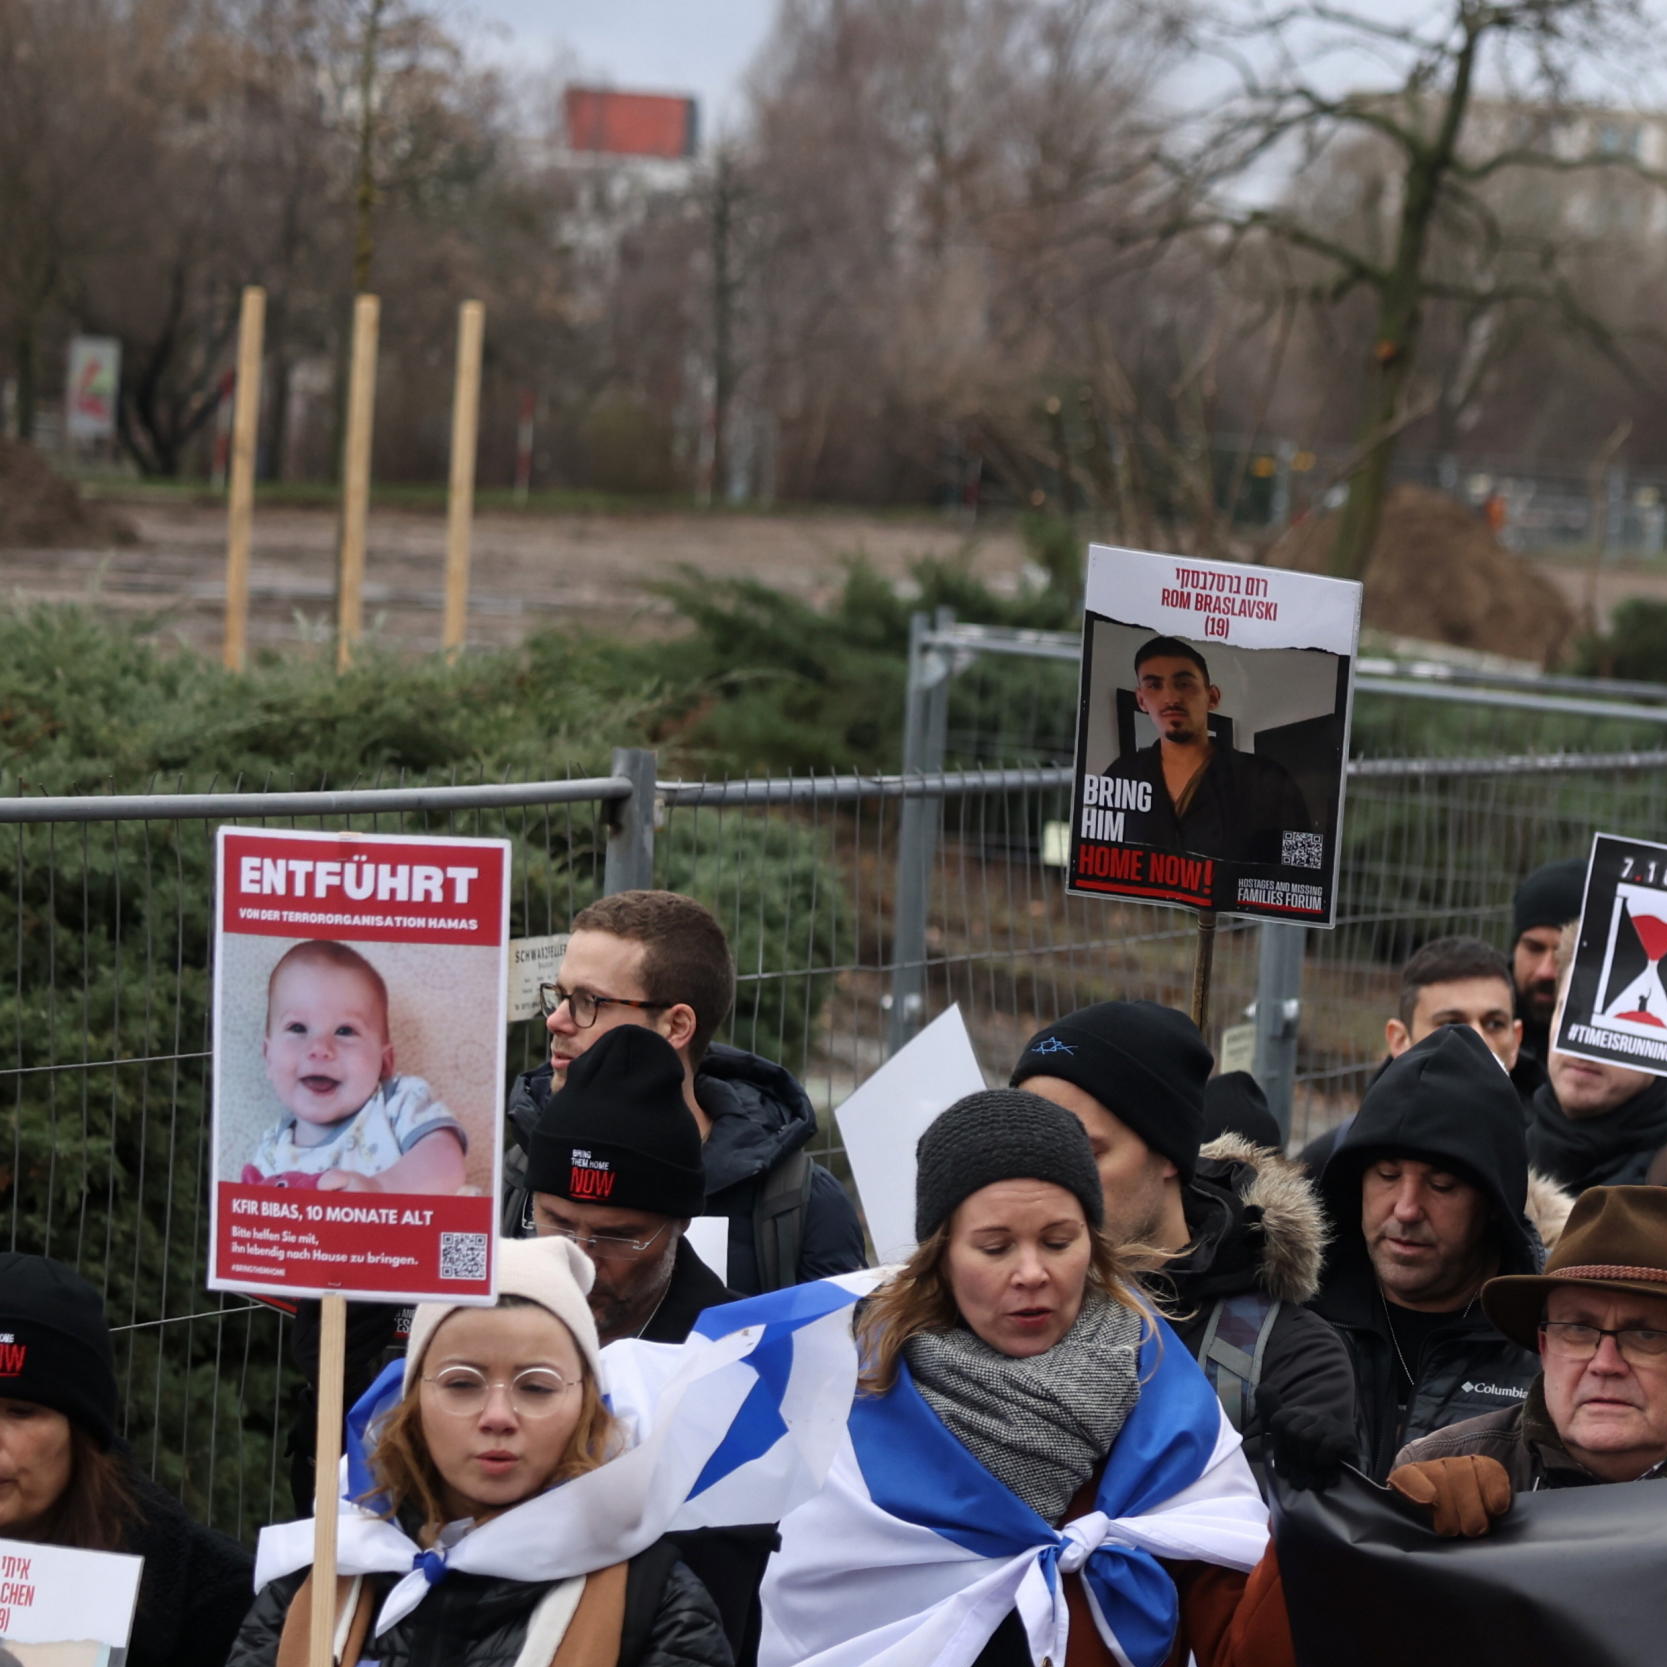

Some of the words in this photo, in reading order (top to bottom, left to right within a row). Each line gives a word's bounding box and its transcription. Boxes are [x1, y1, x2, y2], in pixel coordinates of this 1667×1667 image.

[1176, 567, 1241, 595] ברסלבסקי
[1245, 577, 1268, 598] רום
[1161, 588, 1191, 610] ROM
[1195, 592, 1278, 622] BRASLAVSKI
[1204, 615, 1230, 639] (19)
[1083, 773, 1152, 813] BRING
[1081, 807, 1125, 843] HIM
[240, 855, 479, 904] ENTFÜHRT
[1078, 844, 1144, 881] HOME
[1149, 852, 1215, 895] NOW!
[1237, 887, 1284, 906] FAMILIES
[1285, 892, 1322, 911] FORUM
[1238, 878, 1275, 890] HOSTAGES
[1275, 881, 1290, 893] AND
[1291, 883, 1323, 897] MISSING
[239, 907, 260, 921] VON
[261, 909, 280, 922] DER
[282, 911, 426, 929] TERRORORGANISATION
[428, 918, 478, 931] HAMAS
[571, 1157, 589, 1168] THEM
[590, 1160, 610, 1170] HOME
[570, 1167, 617, 1197] NOW
[232, 1198, 258, 1215] KFIR
[261, 1201, 303, 1222] BIBAS,
[306, 1205, 323, 1221] 10
[326, 1206, 398, 1224] MONATE
[401, 1209, 434, 1226] ALT
[232, 1225, 251, 1238] Bitte
[282, 1230, 296, 1243] Sie
[298, 1233, 319, 1246] mit,
[247, 1242, 285, 1261] lebendig
[287, 1247, 310, 1260] nach
[312, 1249, 348, 1262] Hause
[350, 1254, 365, 1263] zu
[367, 1251, 419, 1268] bringen.
[1474, 1382, 1529, 1399] Columbia
[1, 1582, 35, 1607] CHEN
